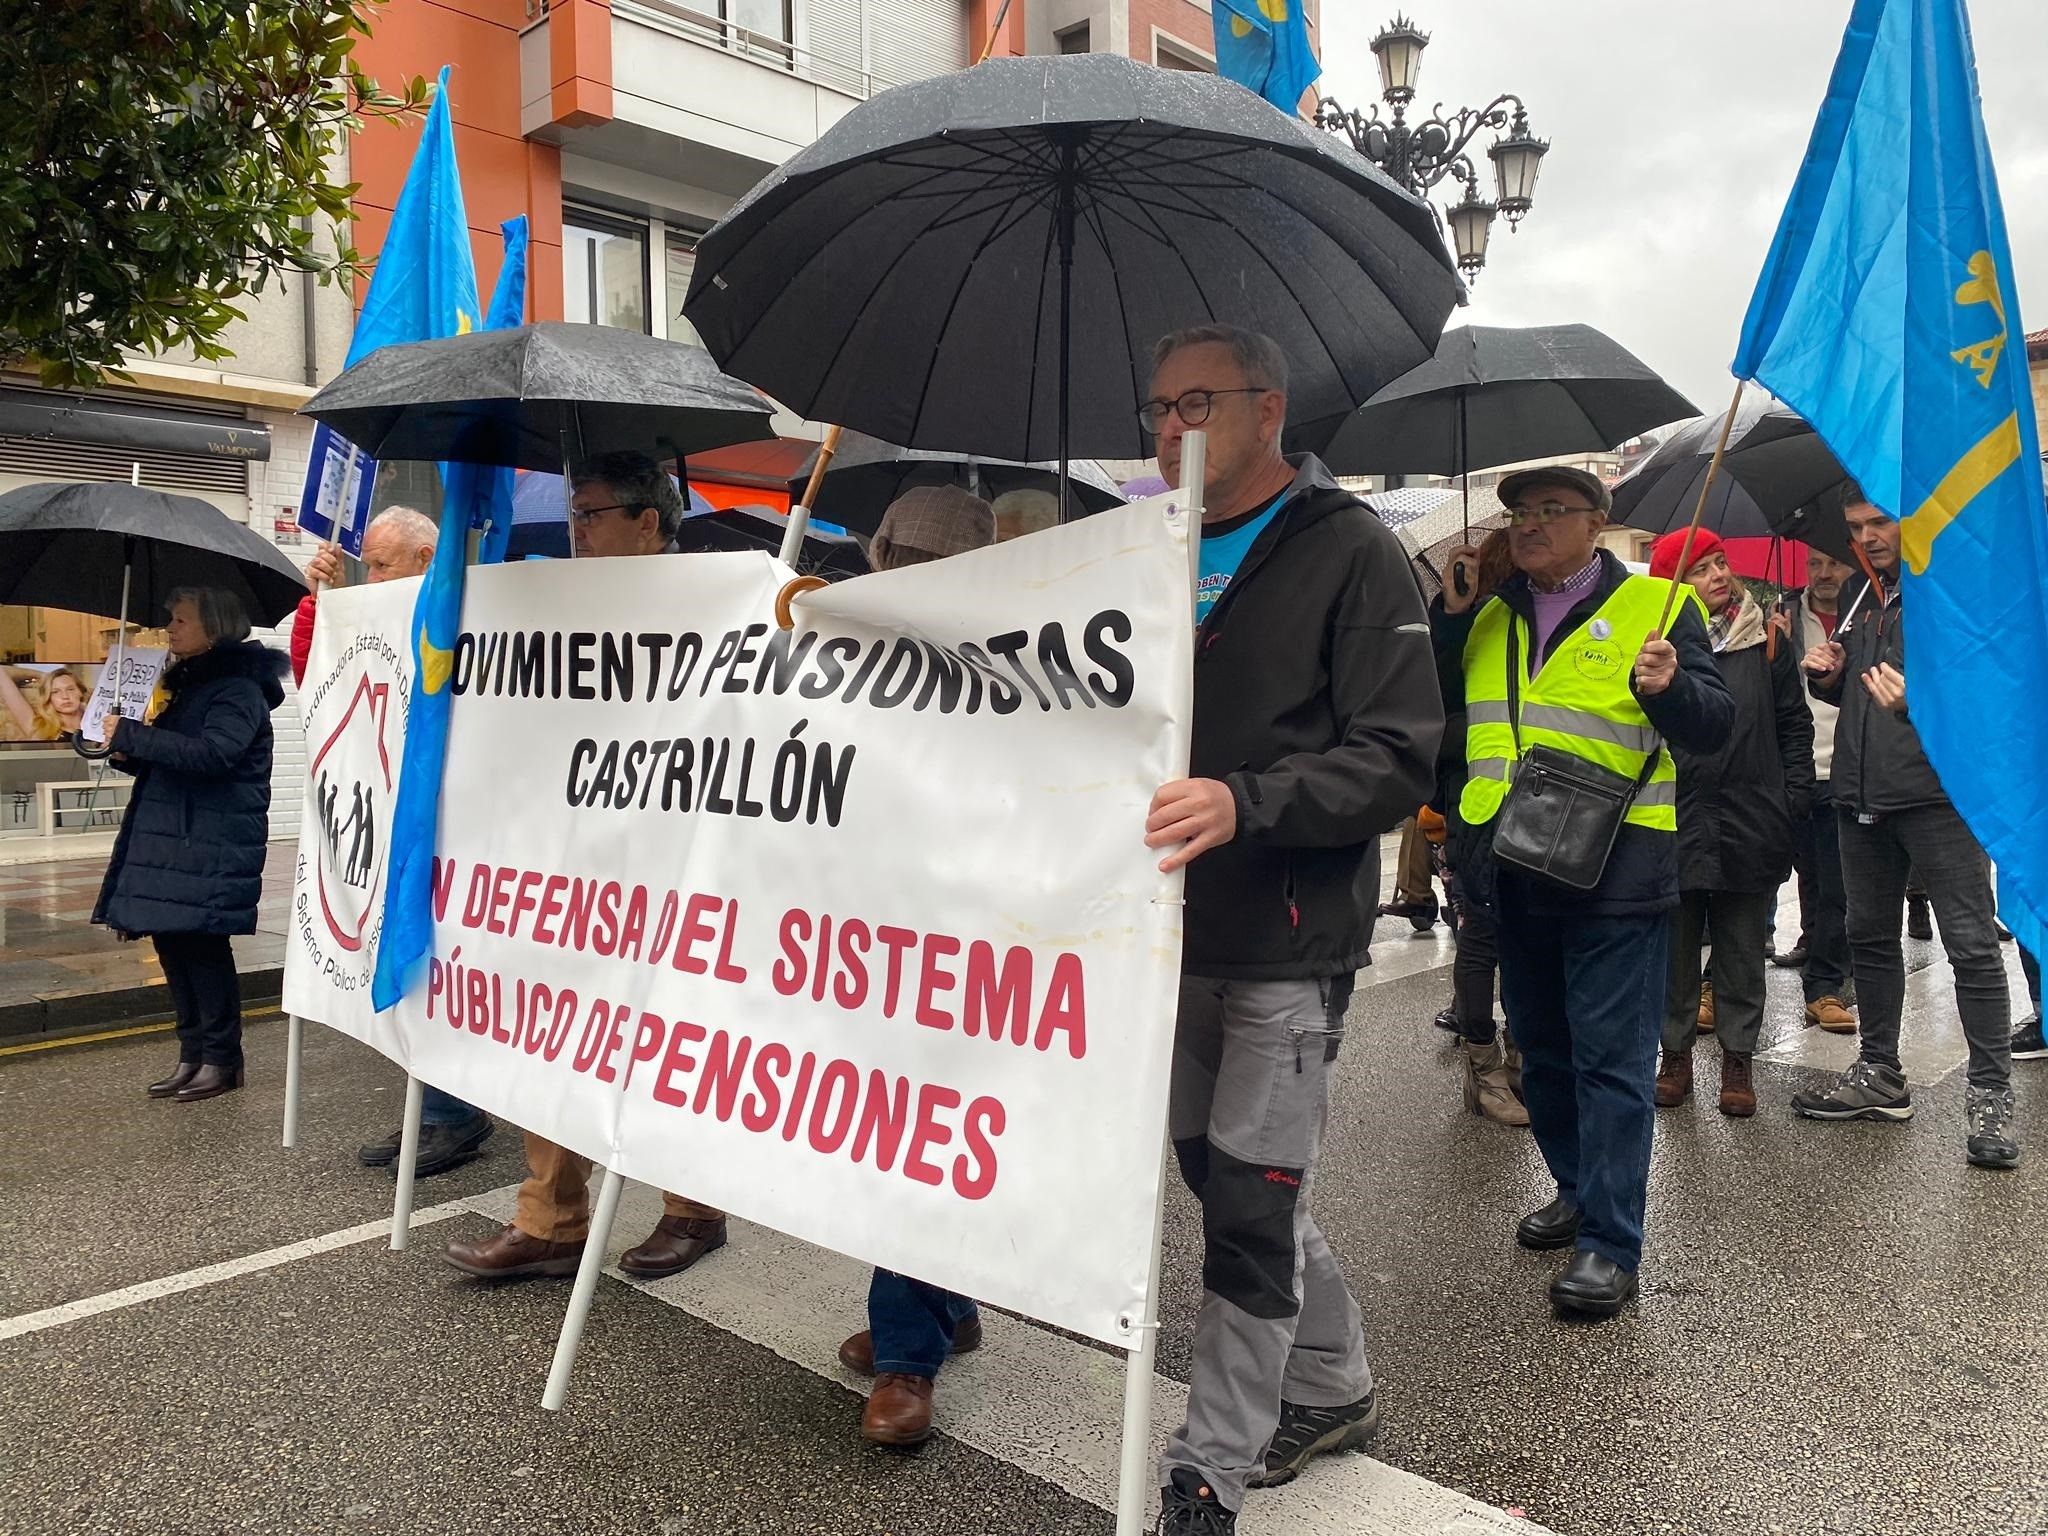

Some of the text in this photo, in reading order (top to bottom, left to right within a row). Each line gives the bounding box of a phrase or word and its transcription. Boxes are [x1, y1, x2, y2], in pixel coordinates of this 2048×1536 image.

[208, 442, 258, 457] VALMONT
[303, 646, 353, 738] ordinadora
[355, 633, 384, 656] Estatal
[380, 642, 398, 667] por
[395, 655, 403, 681] la
[451, 609, 1134, 714] OVIMIENTO PENSIONISTAS
[566, 718, 856, 827] CASTRILLÓN
[297, 853, 307, 886] del
[297, 891, 323, 966] Sistema
[430, 856, 1086, 1059] N DEFENSA DEL SISTEMA
[427, 945, 1006, 1200] PÚBLICO DE PENSIONES
